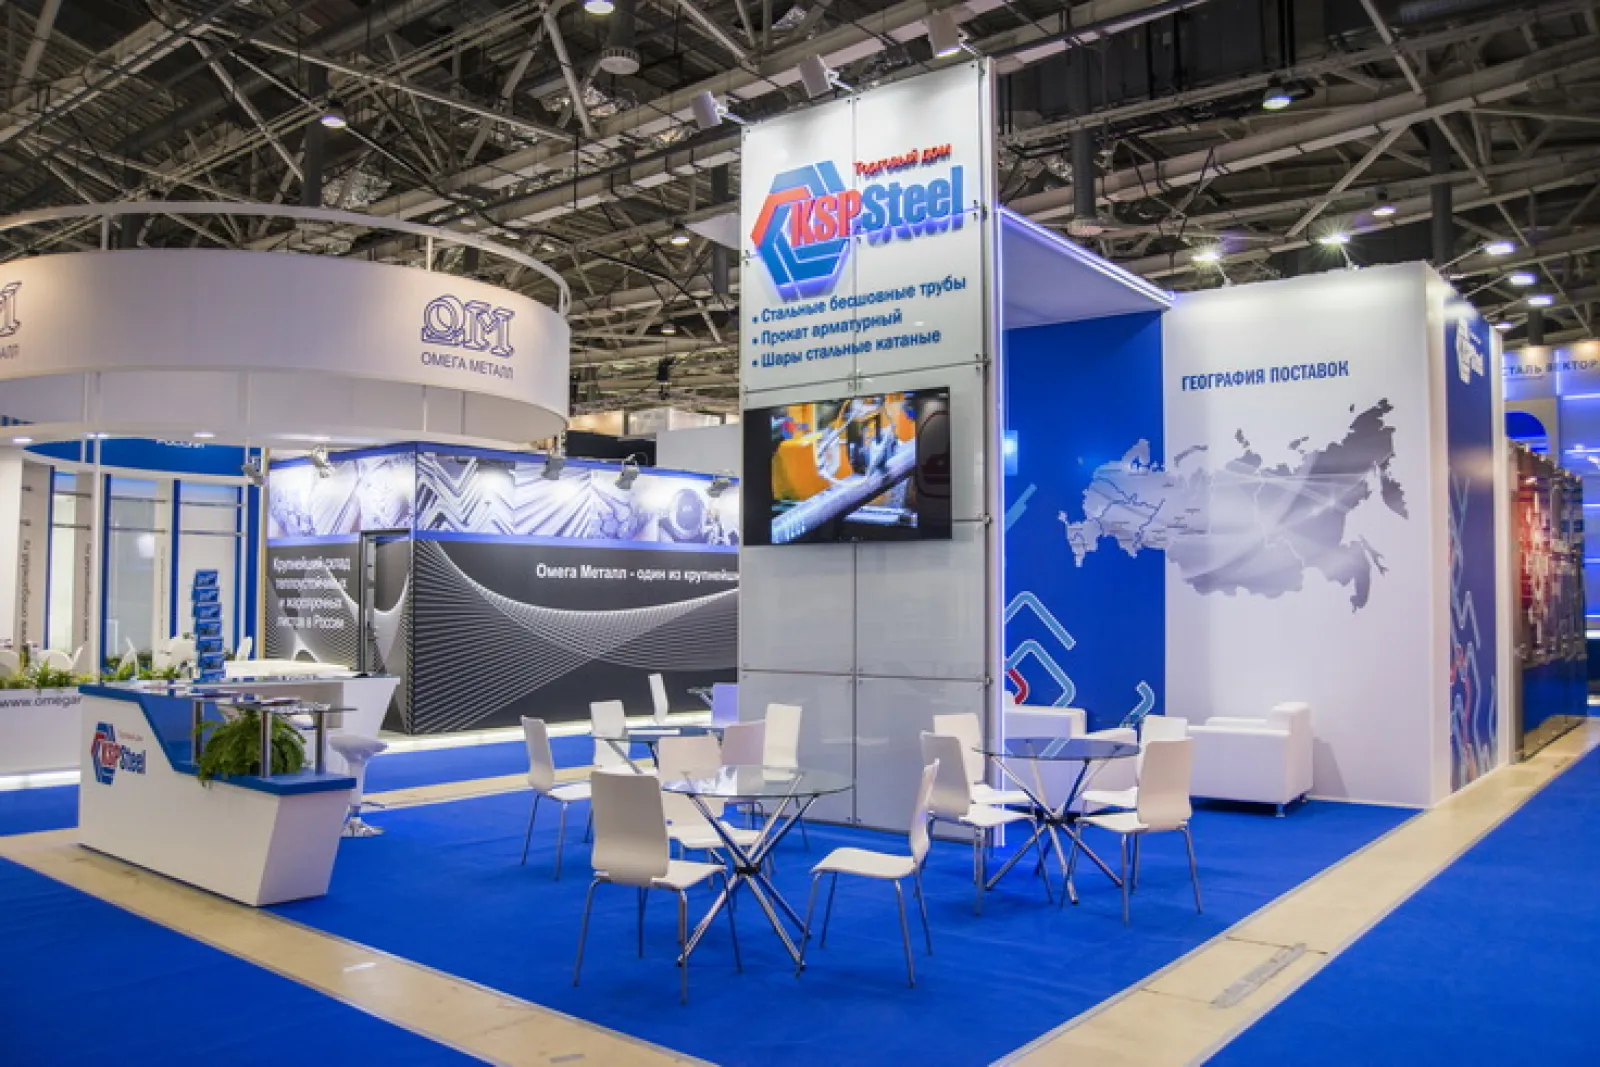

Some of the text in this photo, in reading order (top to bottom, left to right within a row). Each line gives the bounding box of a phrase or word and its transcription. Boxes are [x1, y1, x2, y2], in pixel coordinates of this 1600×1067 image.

[853, 144, 952, 176] Торговый дом
[761, 274, 966, 323] Стальные бесшовные трубы
[761, 309, 903, 347] Прокат арматурный
[421, 351, 514, 379] ОМЕГА МЕТАЛЛ
[761, 330, 941, 368] Шары стальные катаные
[1182, 360, 1349, 391] ГЕОГРАФИЯ ПОСТАВОК
[536, 563, 577, 579] Омега
[579, 564, 627, 579] Металл
[636, 569, 666, 582] один
[668, 570, 681, 581] из
